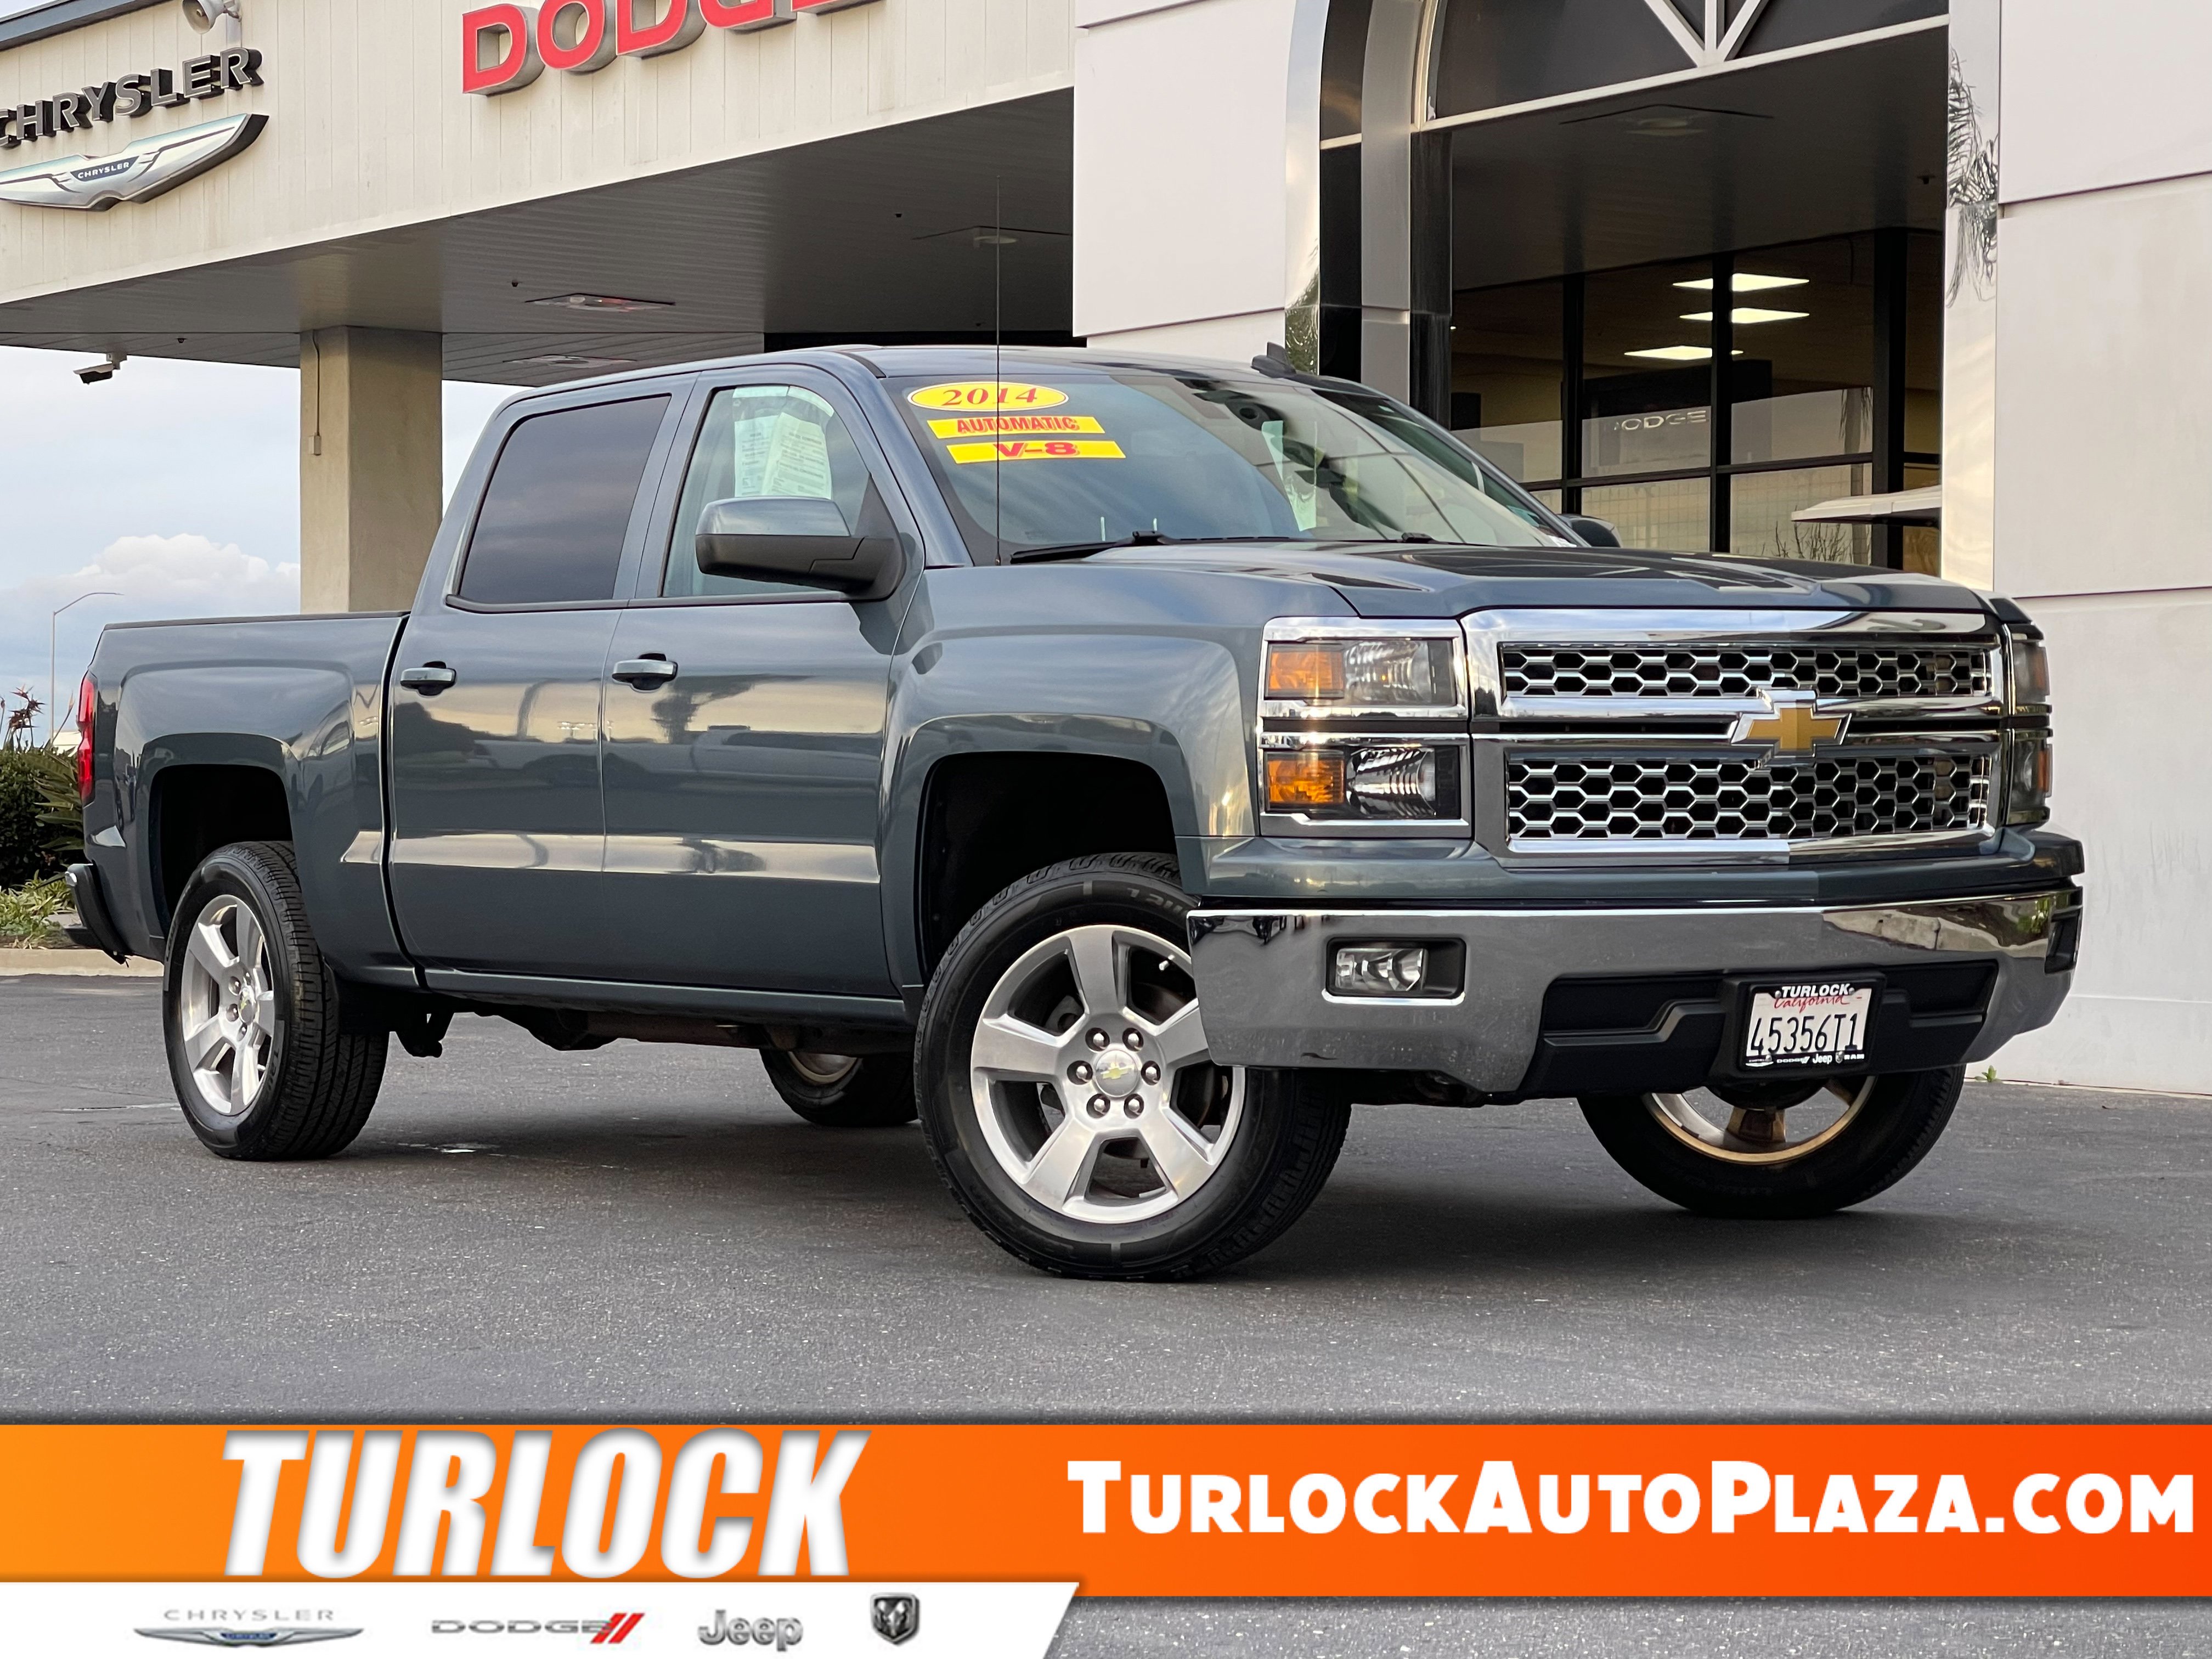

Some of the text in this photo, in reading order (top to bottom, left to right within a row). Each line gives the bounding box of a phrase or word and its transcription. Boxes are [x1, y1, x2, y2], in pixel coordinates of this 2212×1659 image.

[462, 0, 878, 94] DOD
[77, 161, 130, 180] CHRYSLER
[942, 387, 1038, 407] 2014
[957, 416, 1080, 433] AUTOMATIC
[1613, 410, 1707, 431] ODGE
[993, 441, 1081, 458] V-8
[1781, 983, 1851, 998] TURLOCK
[1774, 995, 1850, 1013] California
[1751, 1013, 1858, 1055] 45356T1
[1812, 1053, 1832, 1064] Jeep
